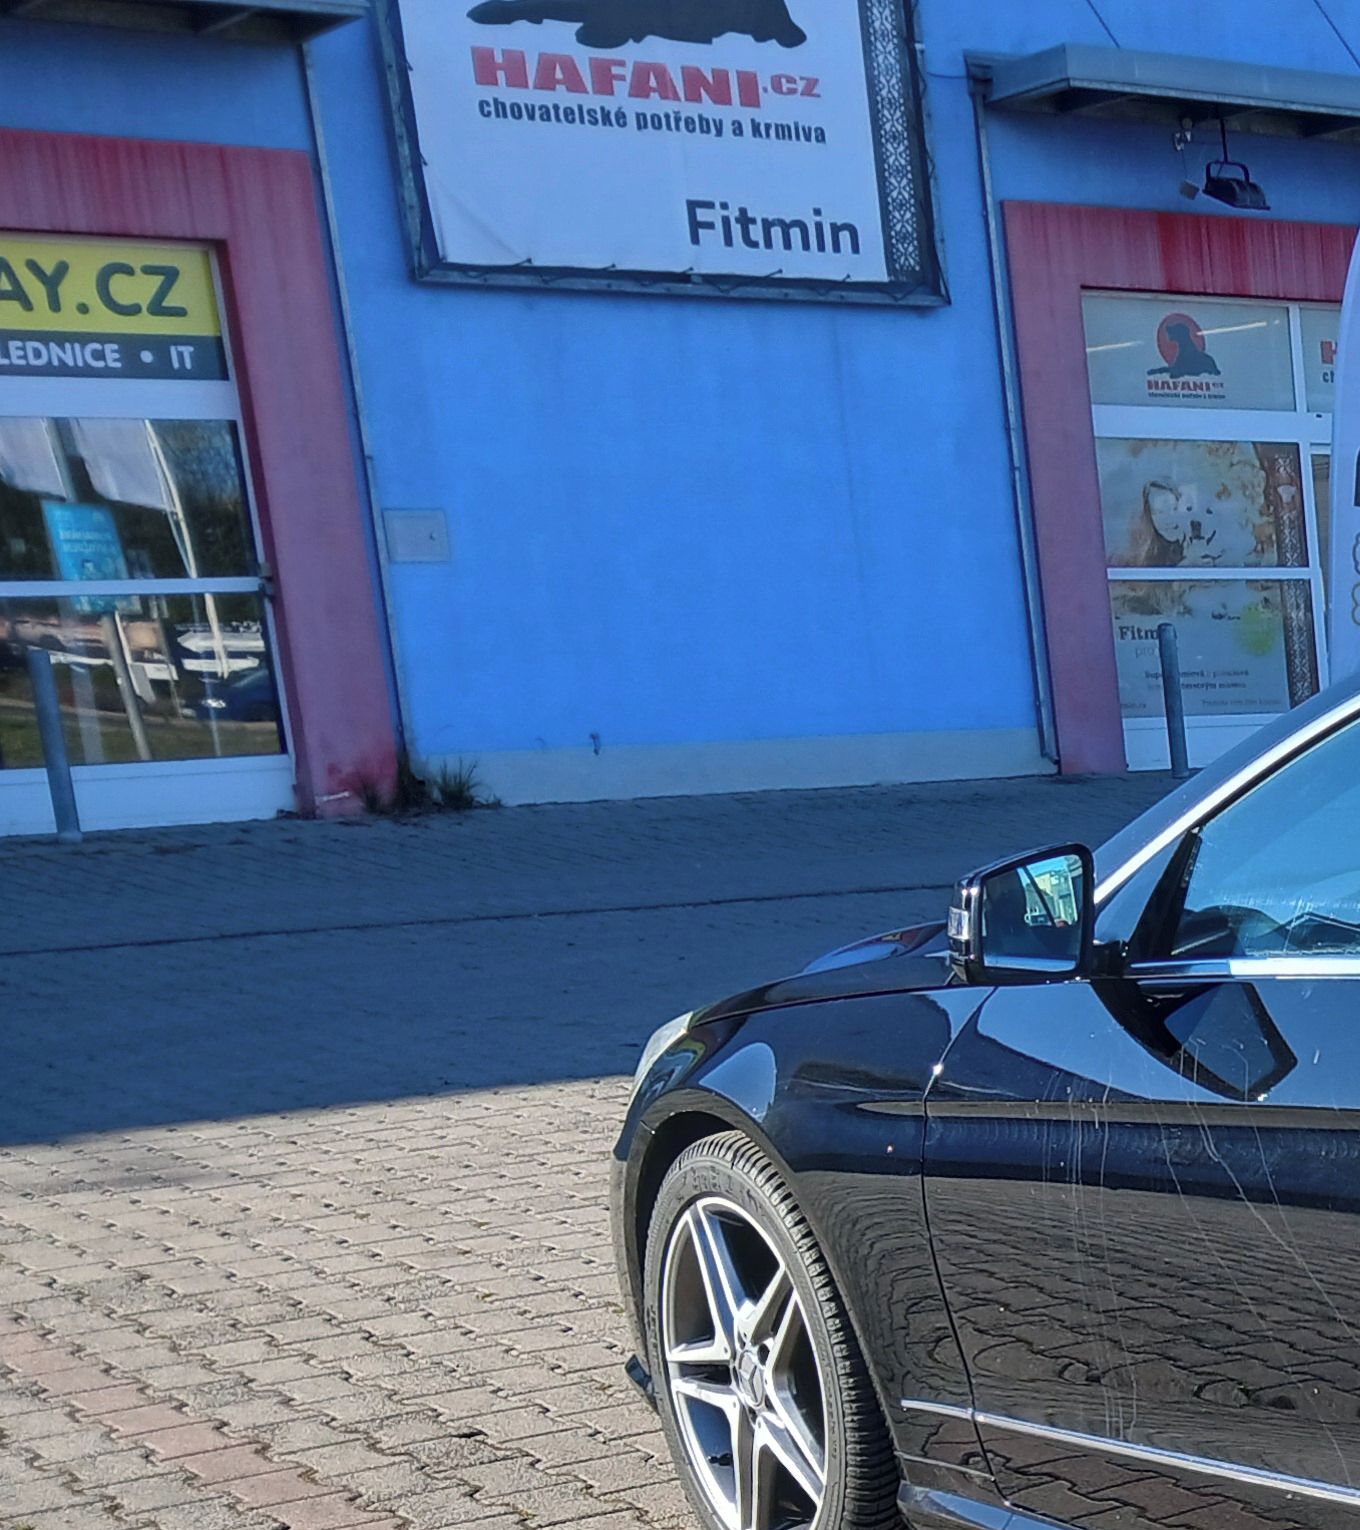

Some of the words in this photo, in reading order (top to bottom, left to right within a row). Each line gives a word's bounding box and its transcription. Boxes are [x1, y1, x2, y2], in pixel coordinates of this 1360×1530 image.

[478, 97, 627, 129] chovatelské
[635, 108, 724, 138] potřeby
[732, 120, 744, 137] a
[750, 117, 826, 144] krmiva
[686, 199, 860, 255] Fitmin
[169, 345, 194, 370] IT
[1119, 625, 1158, 640] Fitm
